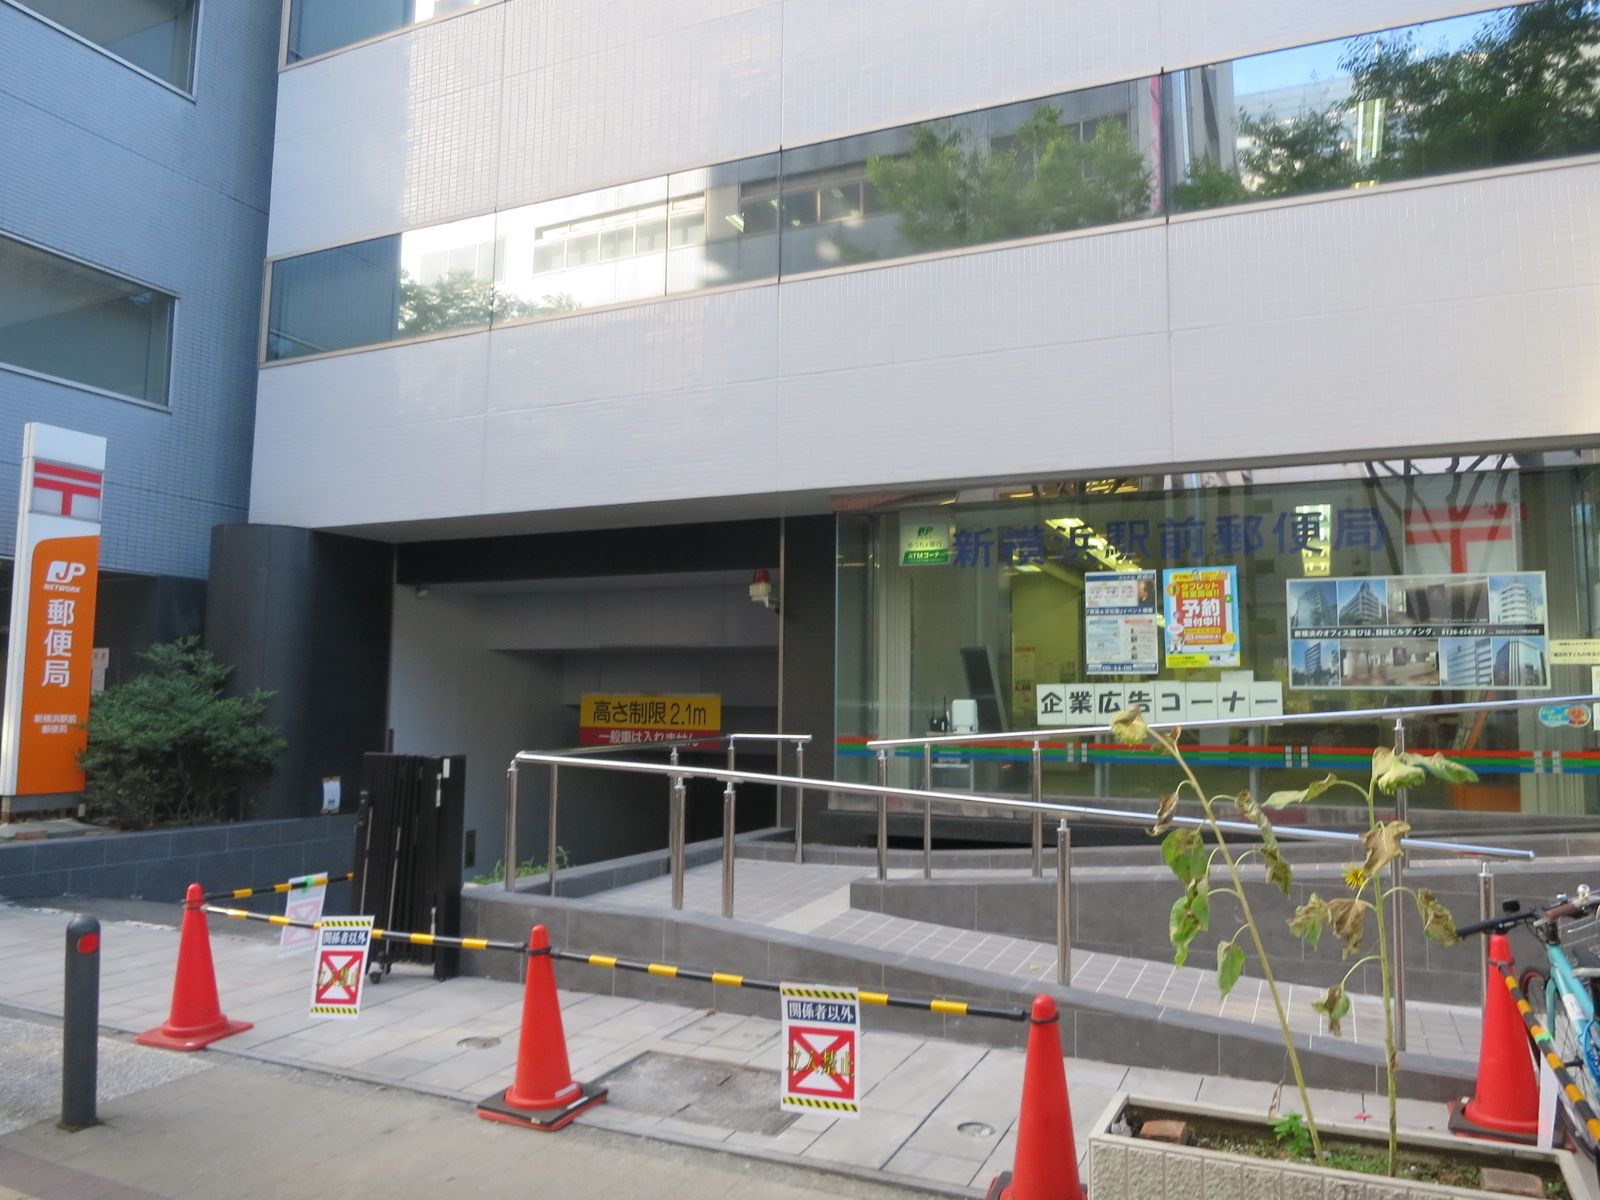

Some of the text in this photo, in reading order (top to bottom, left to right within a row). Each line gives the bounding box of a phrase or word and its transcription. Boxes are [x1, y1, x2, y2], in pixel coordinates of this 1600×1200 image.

[953, 507, 1385, 568] 新横浜駅前郵便局
[44, 583, 81, 593] NETWORK
[1181, 598, 1220, 617] 予約
[41, 598, 76, 688] 郵便局
[1041, 690, 1278, 714] 企業広告コーナー
[322, 930, 368, 946] 関係者以外
[788, 1001, 856, 1024] 関係者以外
